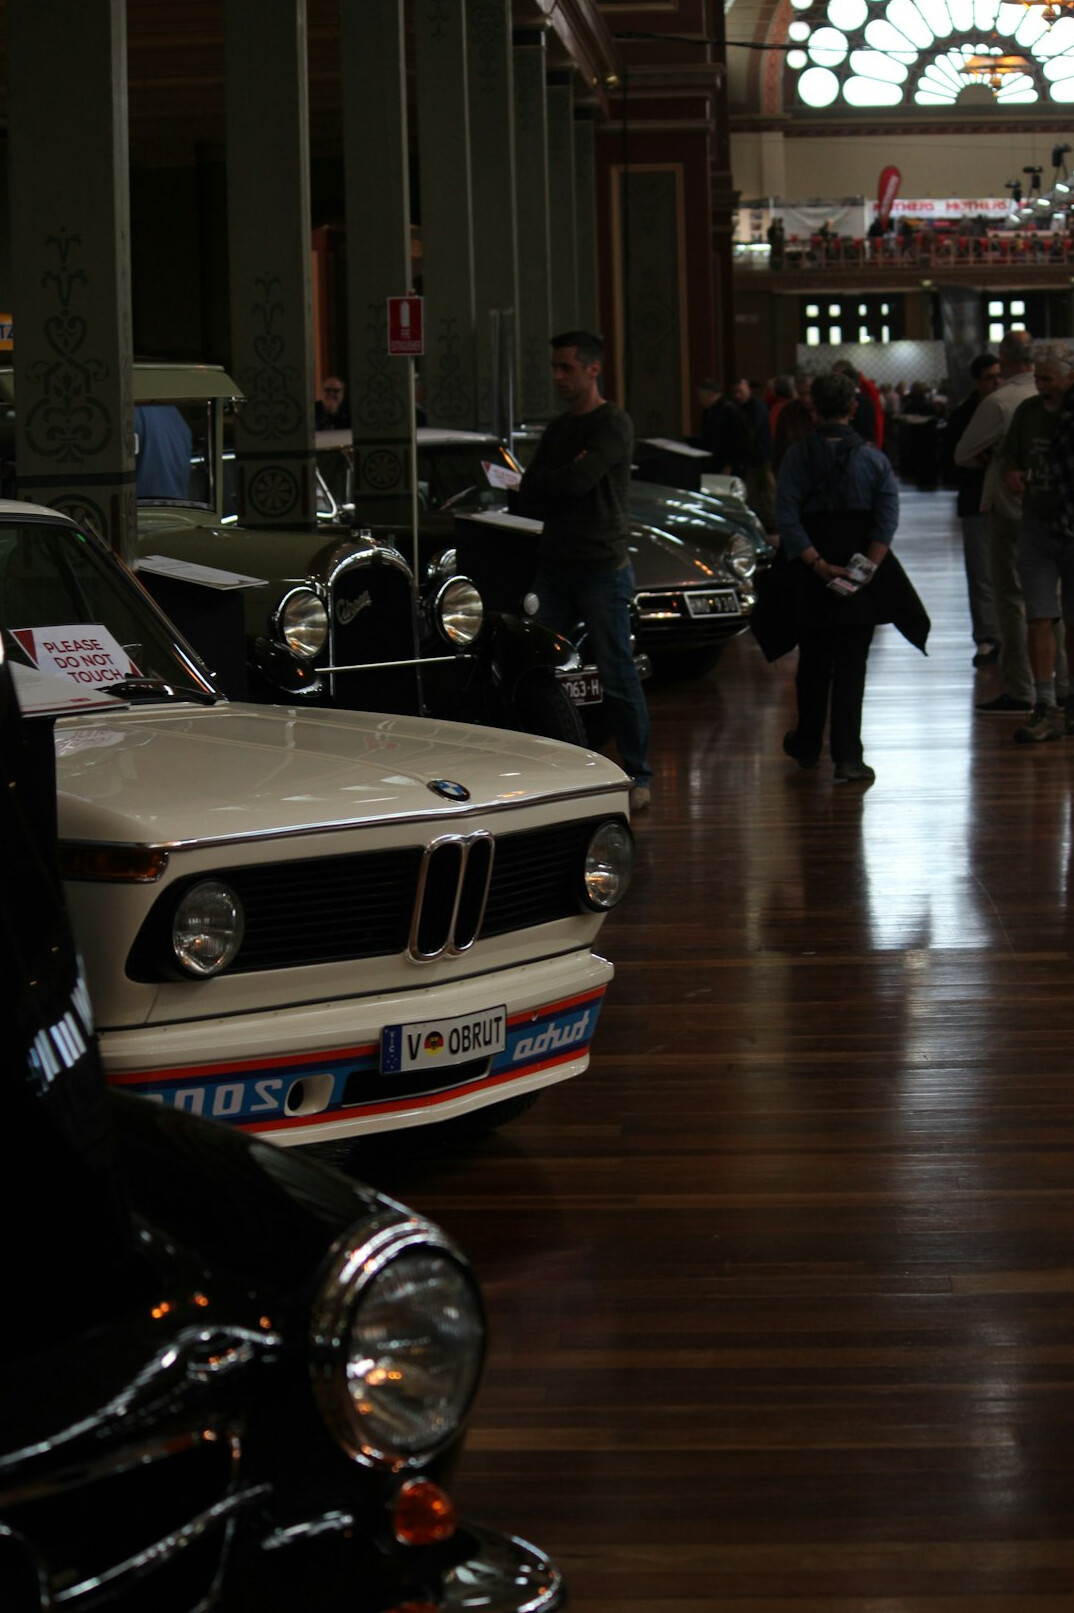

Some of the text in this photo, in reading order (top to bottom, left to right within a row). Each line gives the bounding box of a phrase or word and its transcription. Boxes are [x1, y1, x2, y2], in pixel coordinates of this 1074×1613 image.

[43, 639, 104, 653] PLEASE
[54, 654, 114, 669] DO NOT
[67, 669, 125, 683] TOUCH
[408, 1016, 502, 1060] V OBRUT
